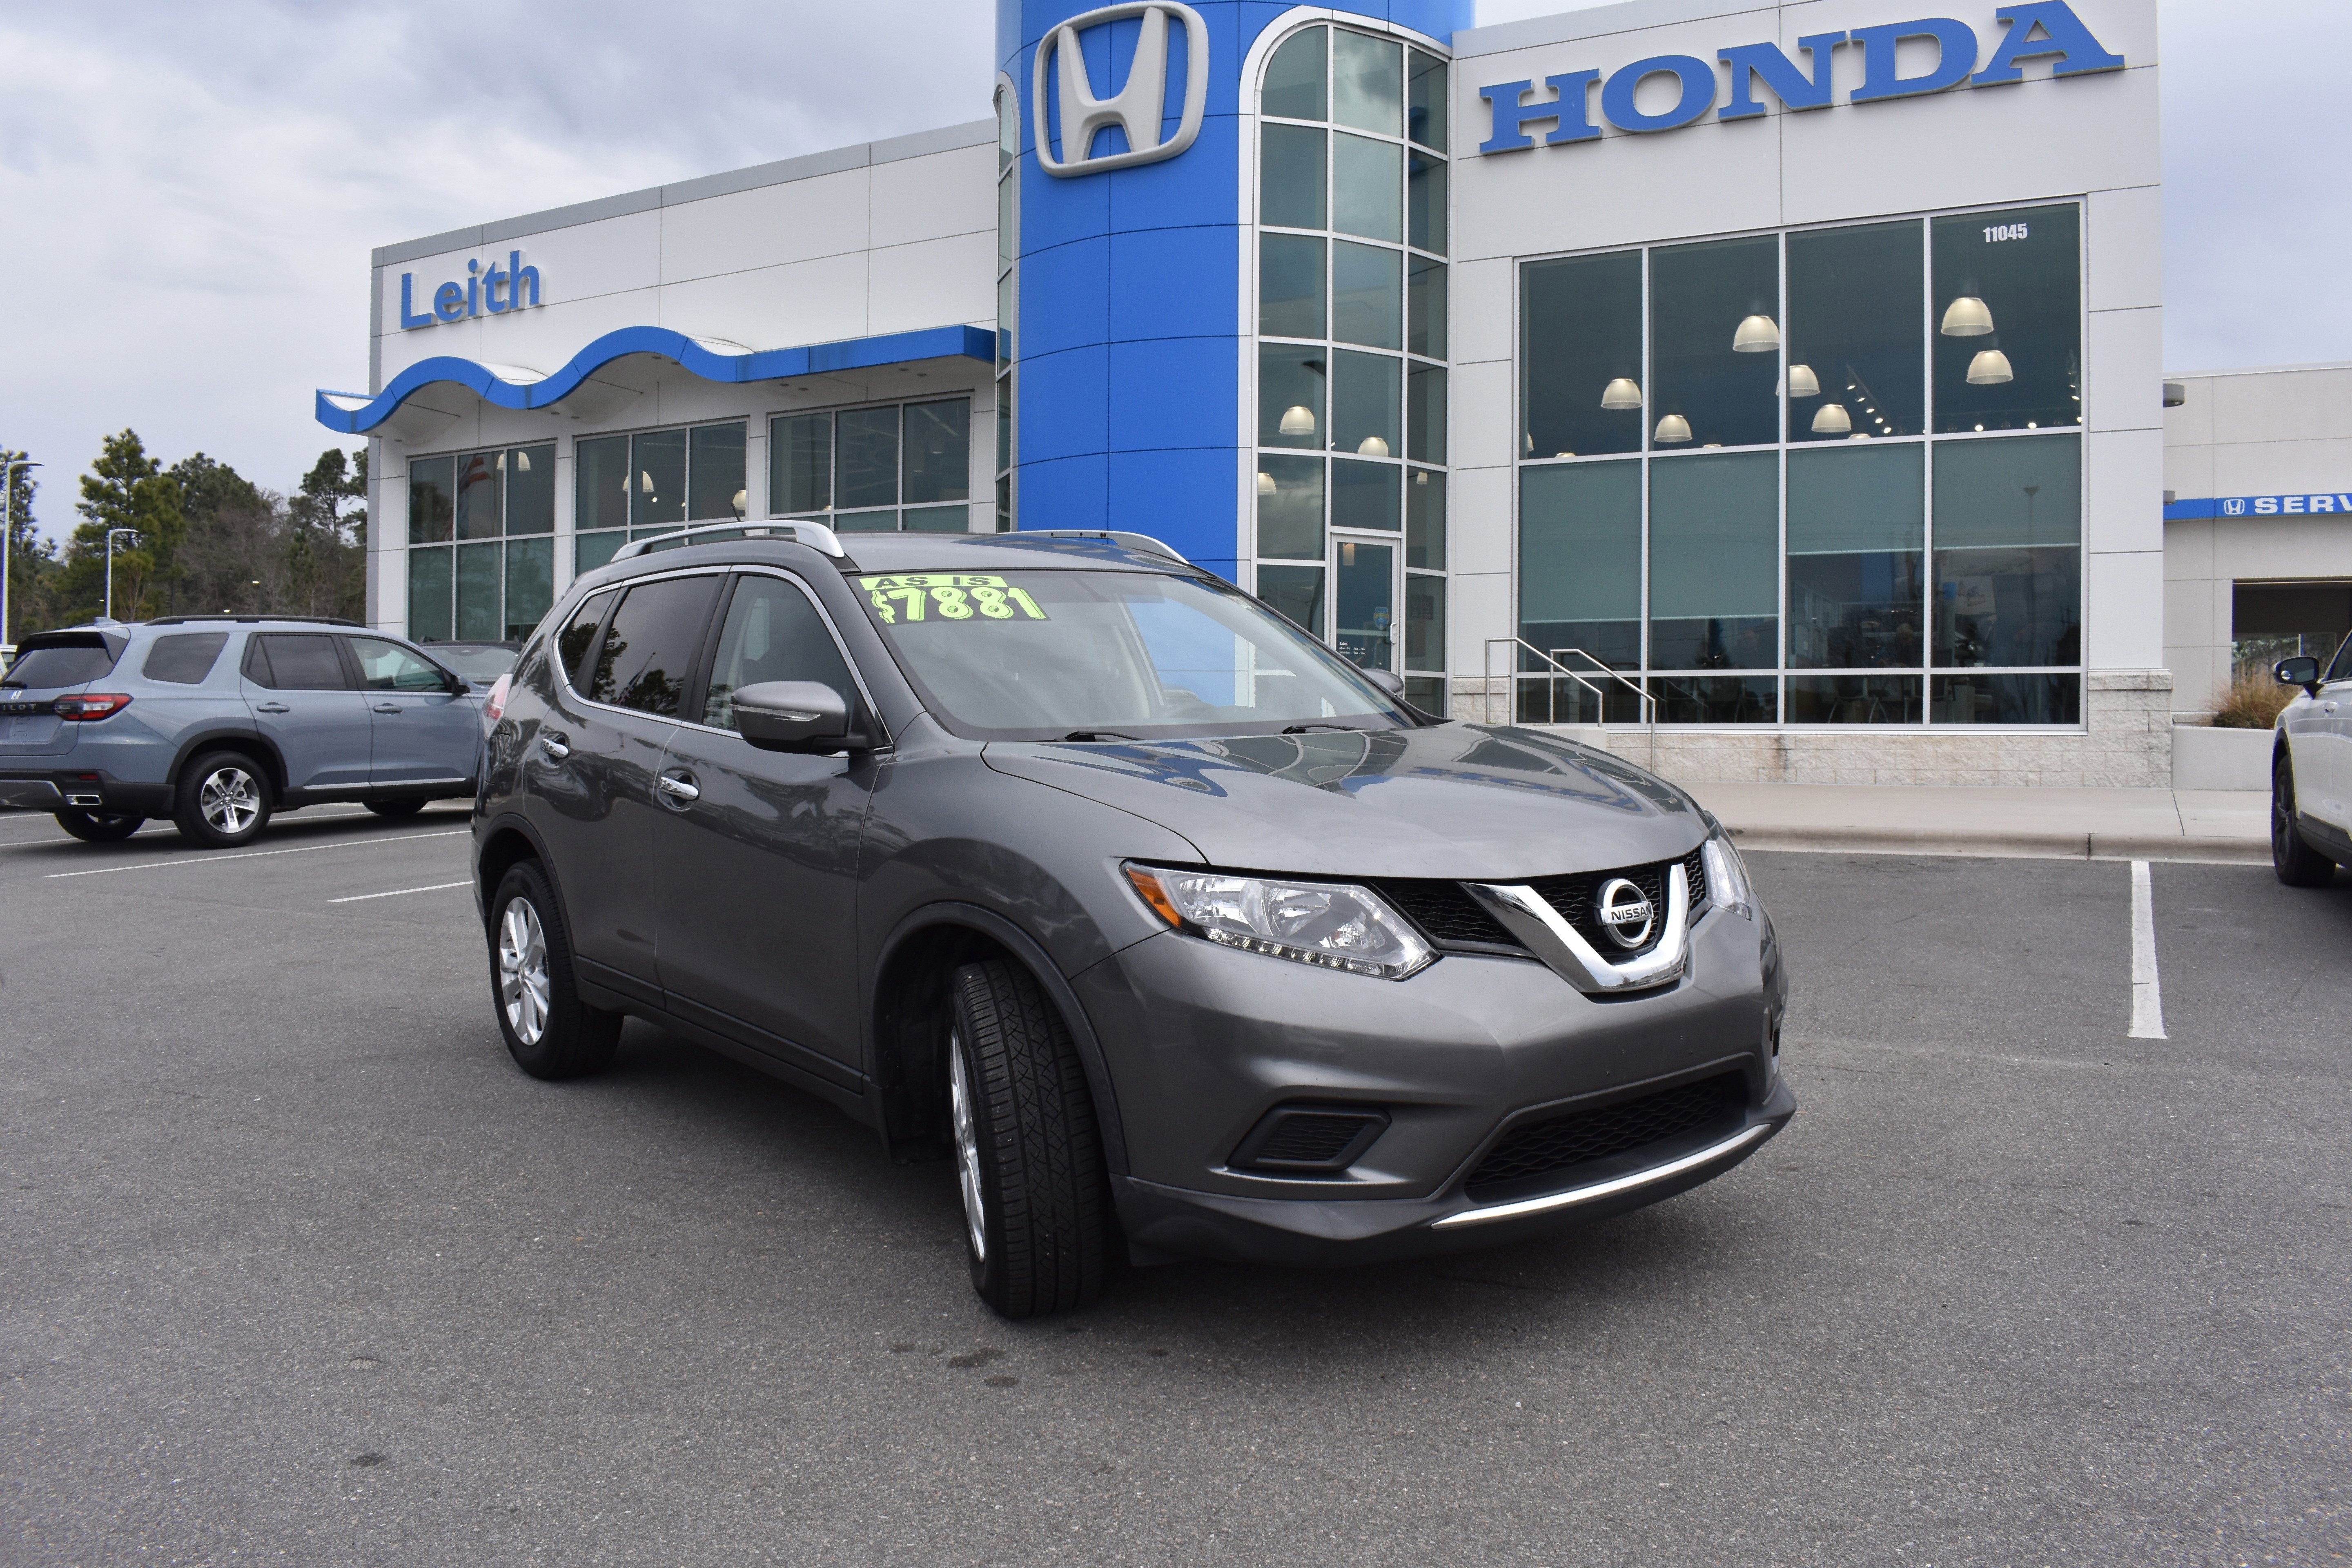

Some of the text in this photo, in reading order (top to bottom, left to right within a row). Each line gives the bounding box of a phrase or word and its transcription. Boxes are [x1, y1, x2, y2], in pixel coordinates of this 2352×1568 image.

[1479, 0, 2125, 155] HONDA
[1983, 223, 2028, 243] 11045
[401, 250, 544, 330] Leith
[874, 576, 991, 588] AS IS
[871, 586, 1046, 624] $7881
[1610, 902, 1652, 921] NISSAN
